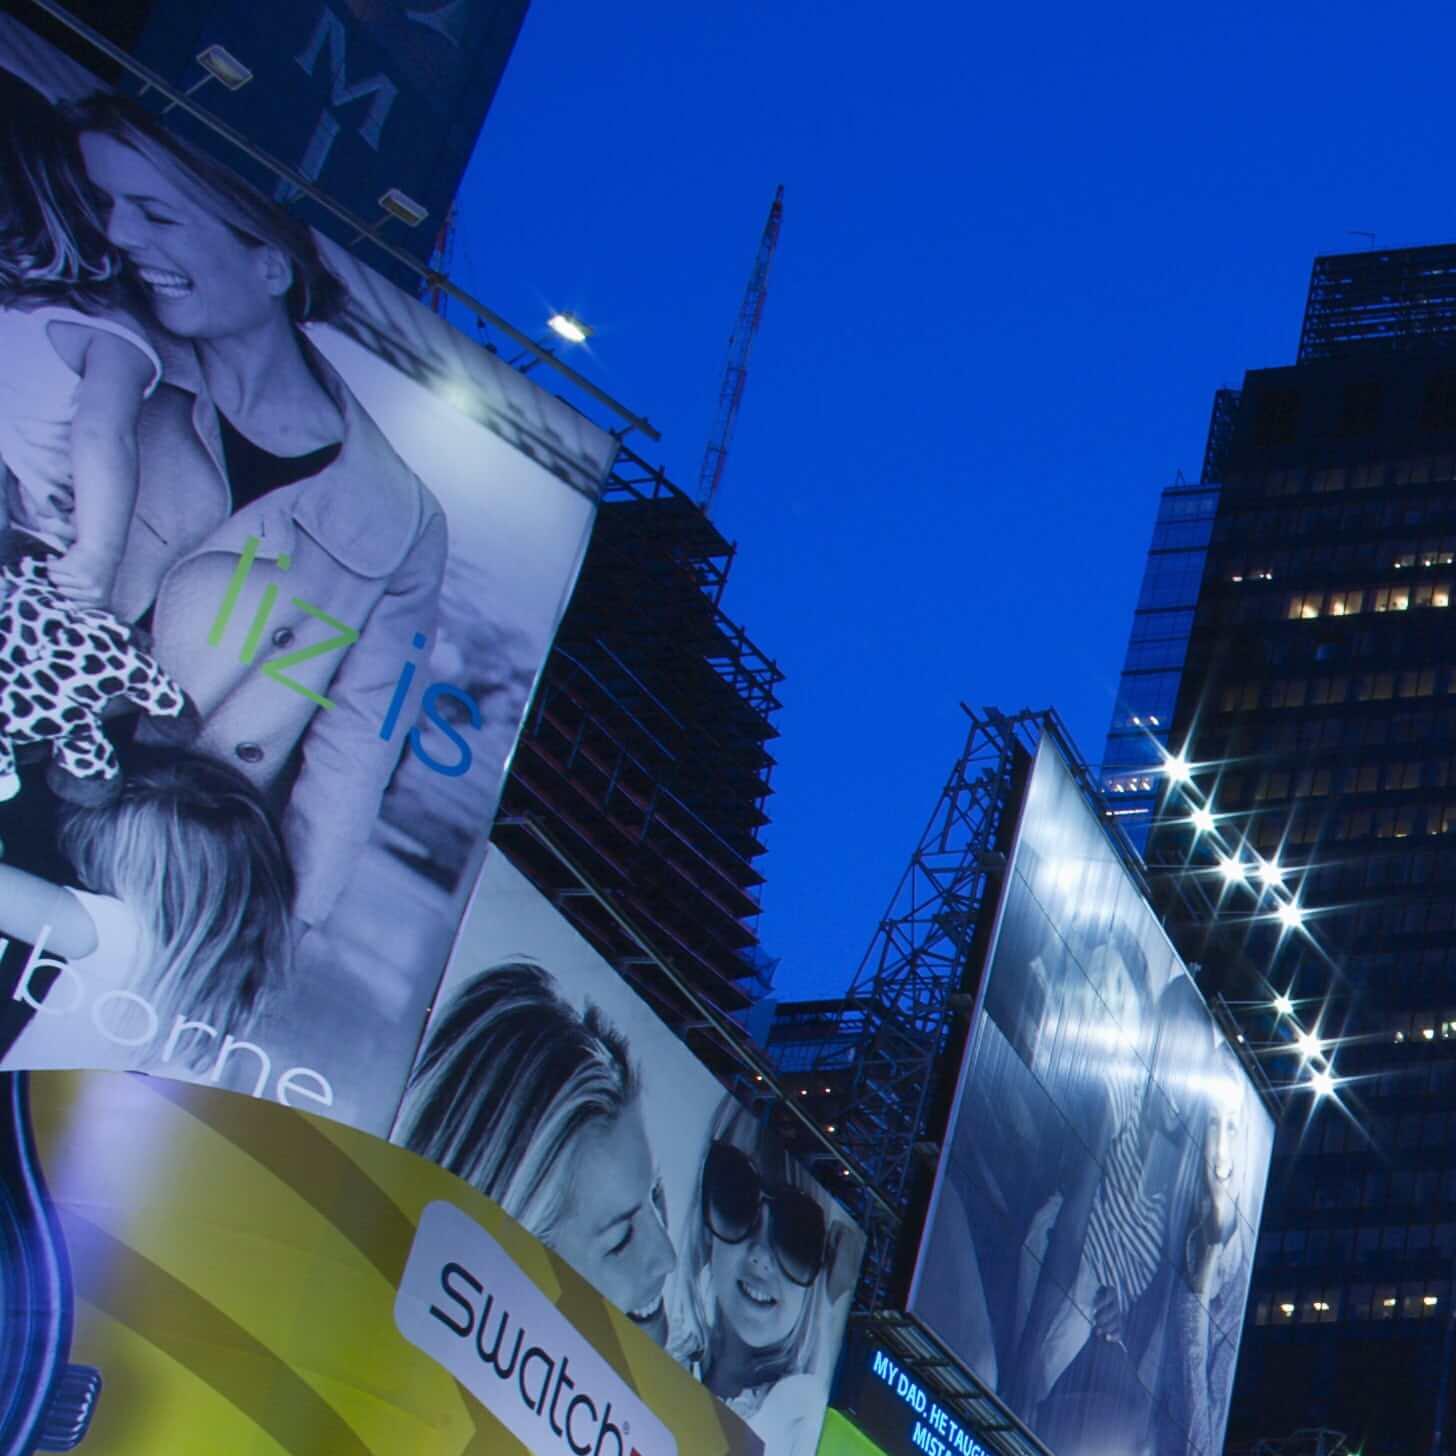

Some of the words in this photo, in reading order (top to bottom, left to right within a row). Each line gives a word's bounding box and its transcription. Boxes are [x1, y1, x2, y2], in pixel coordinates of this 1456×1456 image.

[207, 535, 360, 710] liz
[380, 632, 483, 777] is
[0, 924, 333, 1106] borne
[872, 1350, 898, 1386] MY
[897, 1375, 928, 1418] DAD.
[929, 1404, 948, 1434] HE
